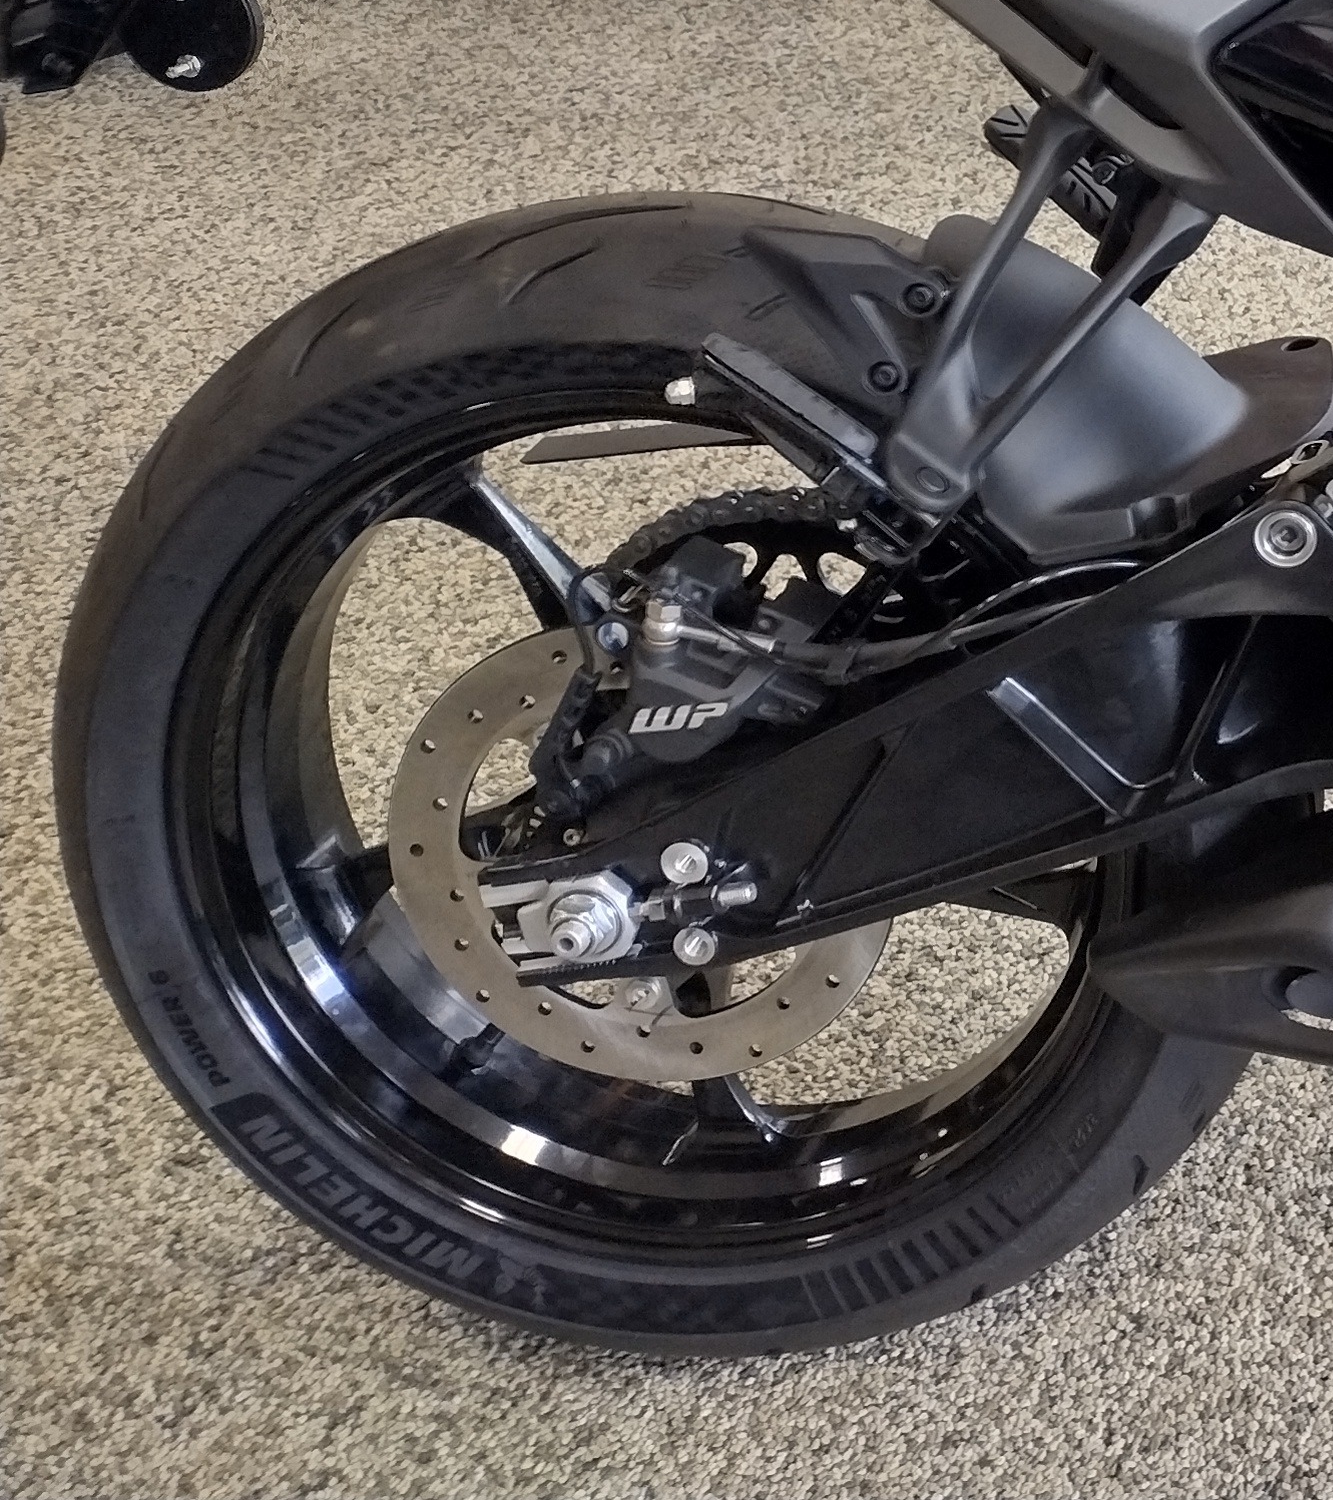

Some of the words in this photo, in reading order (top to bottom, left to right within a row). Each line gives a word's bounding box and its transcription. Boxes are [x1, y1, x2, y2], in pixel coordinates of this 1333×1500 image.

[628, 701, 729, 733] WP
[147, 968, 170, 986] 6
[162, 994, 232, 1089] POWER
[239, 1112, 486, 1280] MICHELIN
